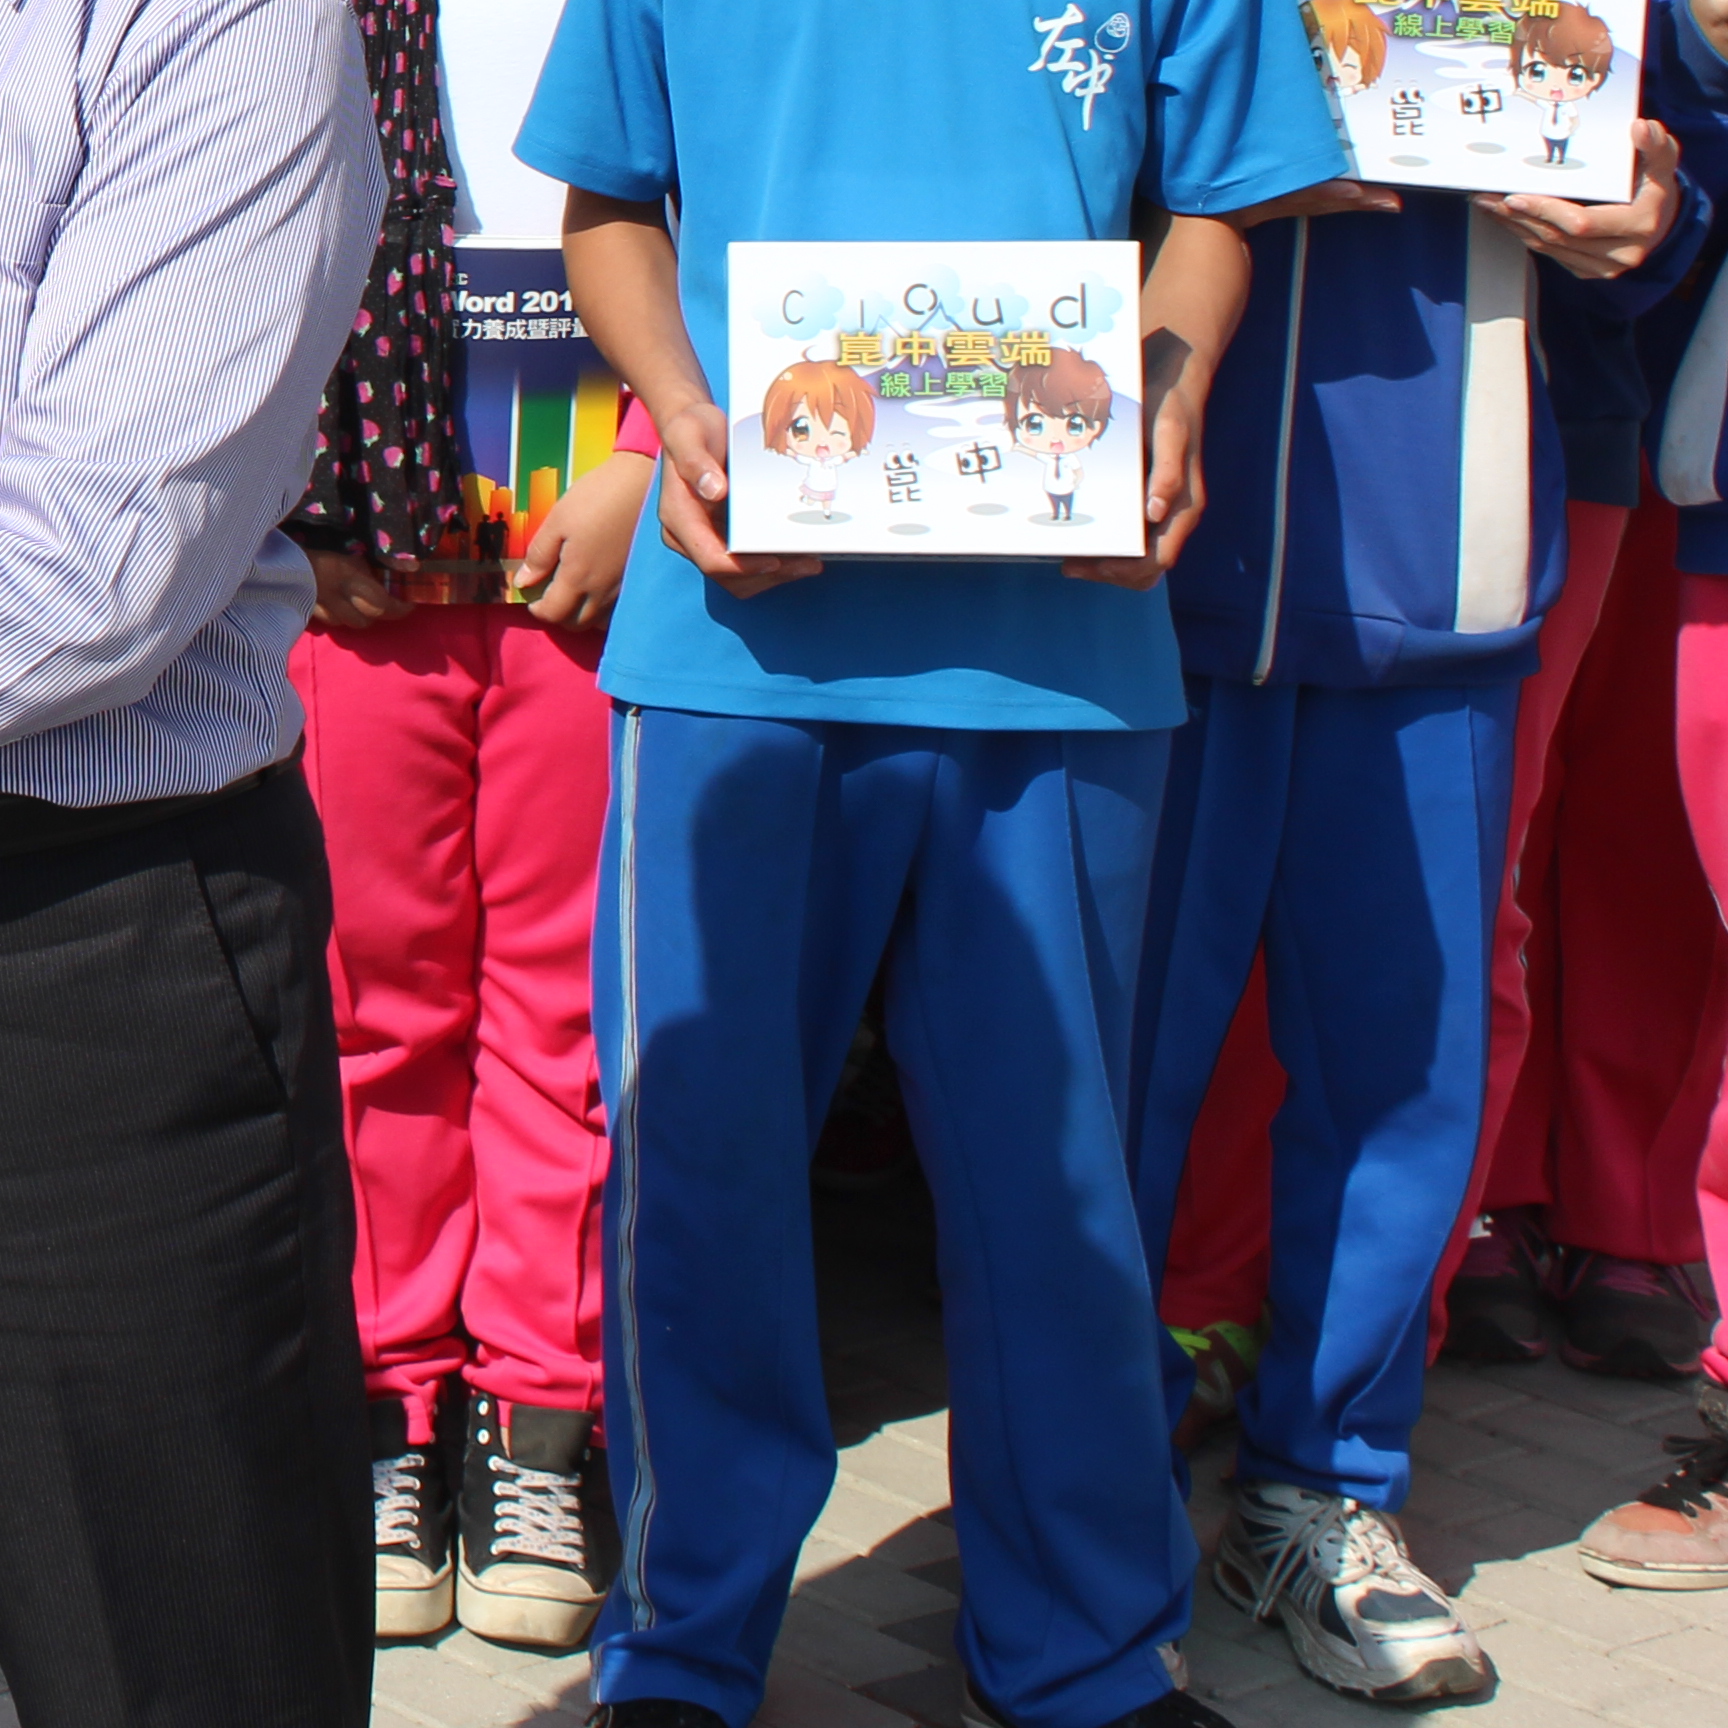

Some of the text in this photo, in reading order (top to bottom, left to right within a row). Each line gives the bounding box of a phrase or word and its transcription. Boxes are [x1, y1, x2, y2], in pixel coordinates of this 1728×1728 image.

[1393, 13, 1516, 45] 線上學習
[520, 290, 573, 313] 201
[452, 318, 589, 340] 力養成暨評量
[880, 372, 1008, 398] 線上學習
